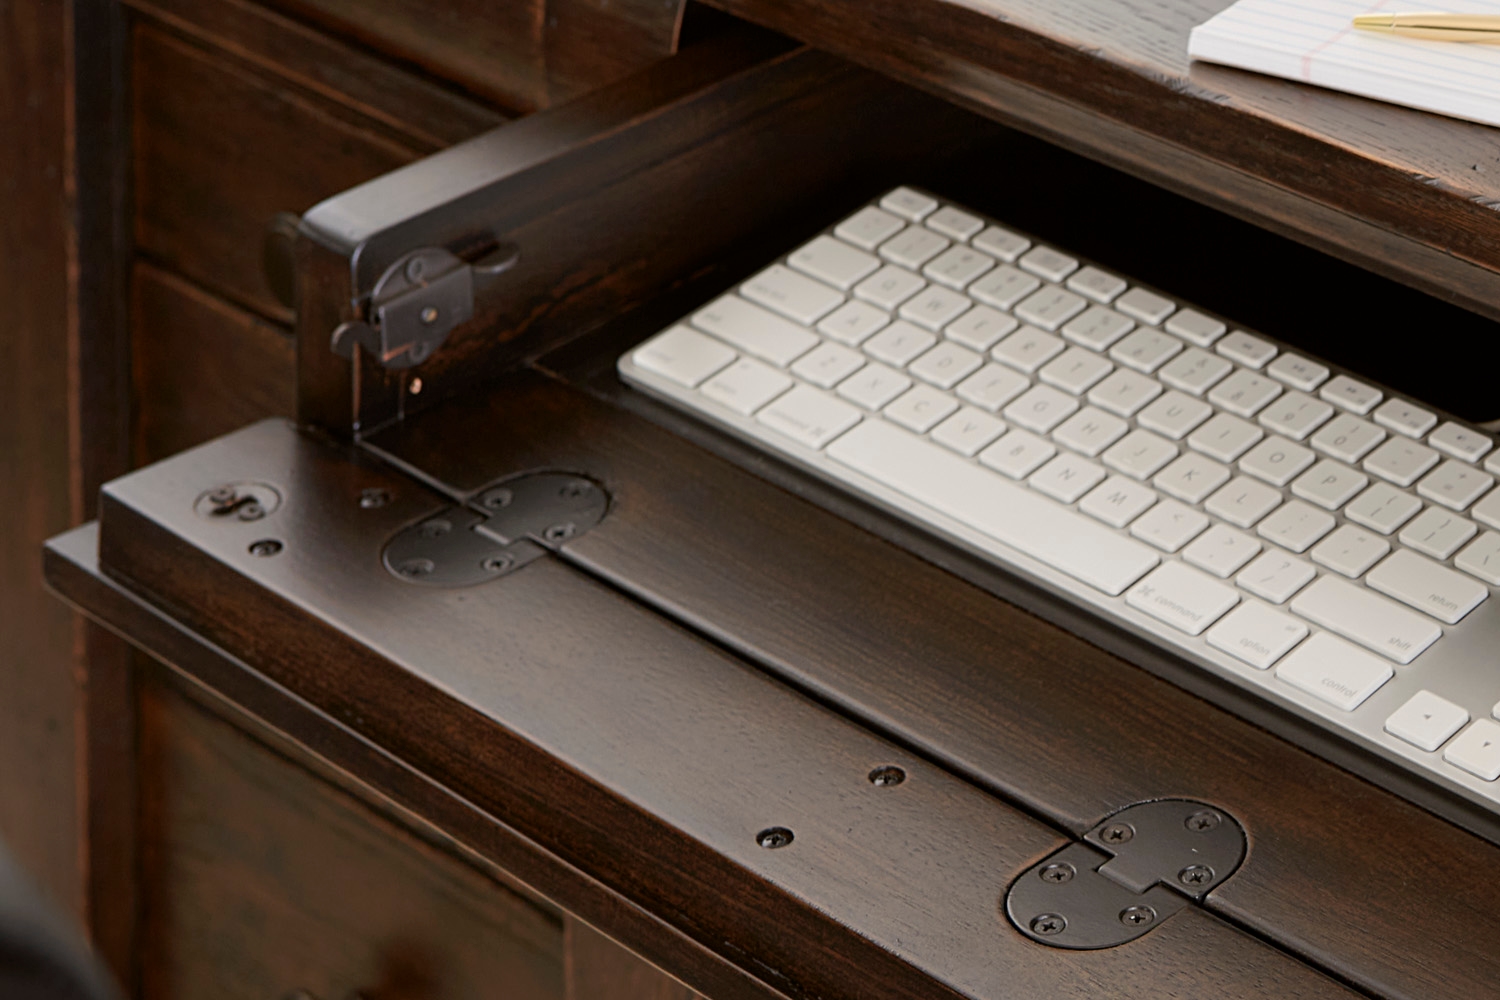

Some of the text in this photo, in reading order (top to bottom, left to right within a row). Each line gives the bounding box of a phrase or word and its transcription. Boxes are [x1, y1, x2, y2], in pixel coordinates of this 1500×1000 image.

[1165, 405, 1184, 418] U
[962, 422, 977, 434] V
[1081, 422, 1099, 435] H
[1058, 467, 1076, 481] N
[1182, 469, 1201, 481] K
[1321, 474, 1338, 485] P
[1106, 491, 1128, 506] M
[1235, 492, 1248, 505] L
[1154, 595, 1204, 622] command
[1428, 593, 1459, 612] return
[1239, 637, 1271, 656] option
[1387, 637, 1412, 651] shift
[1321, 676, 1358, 699] control
